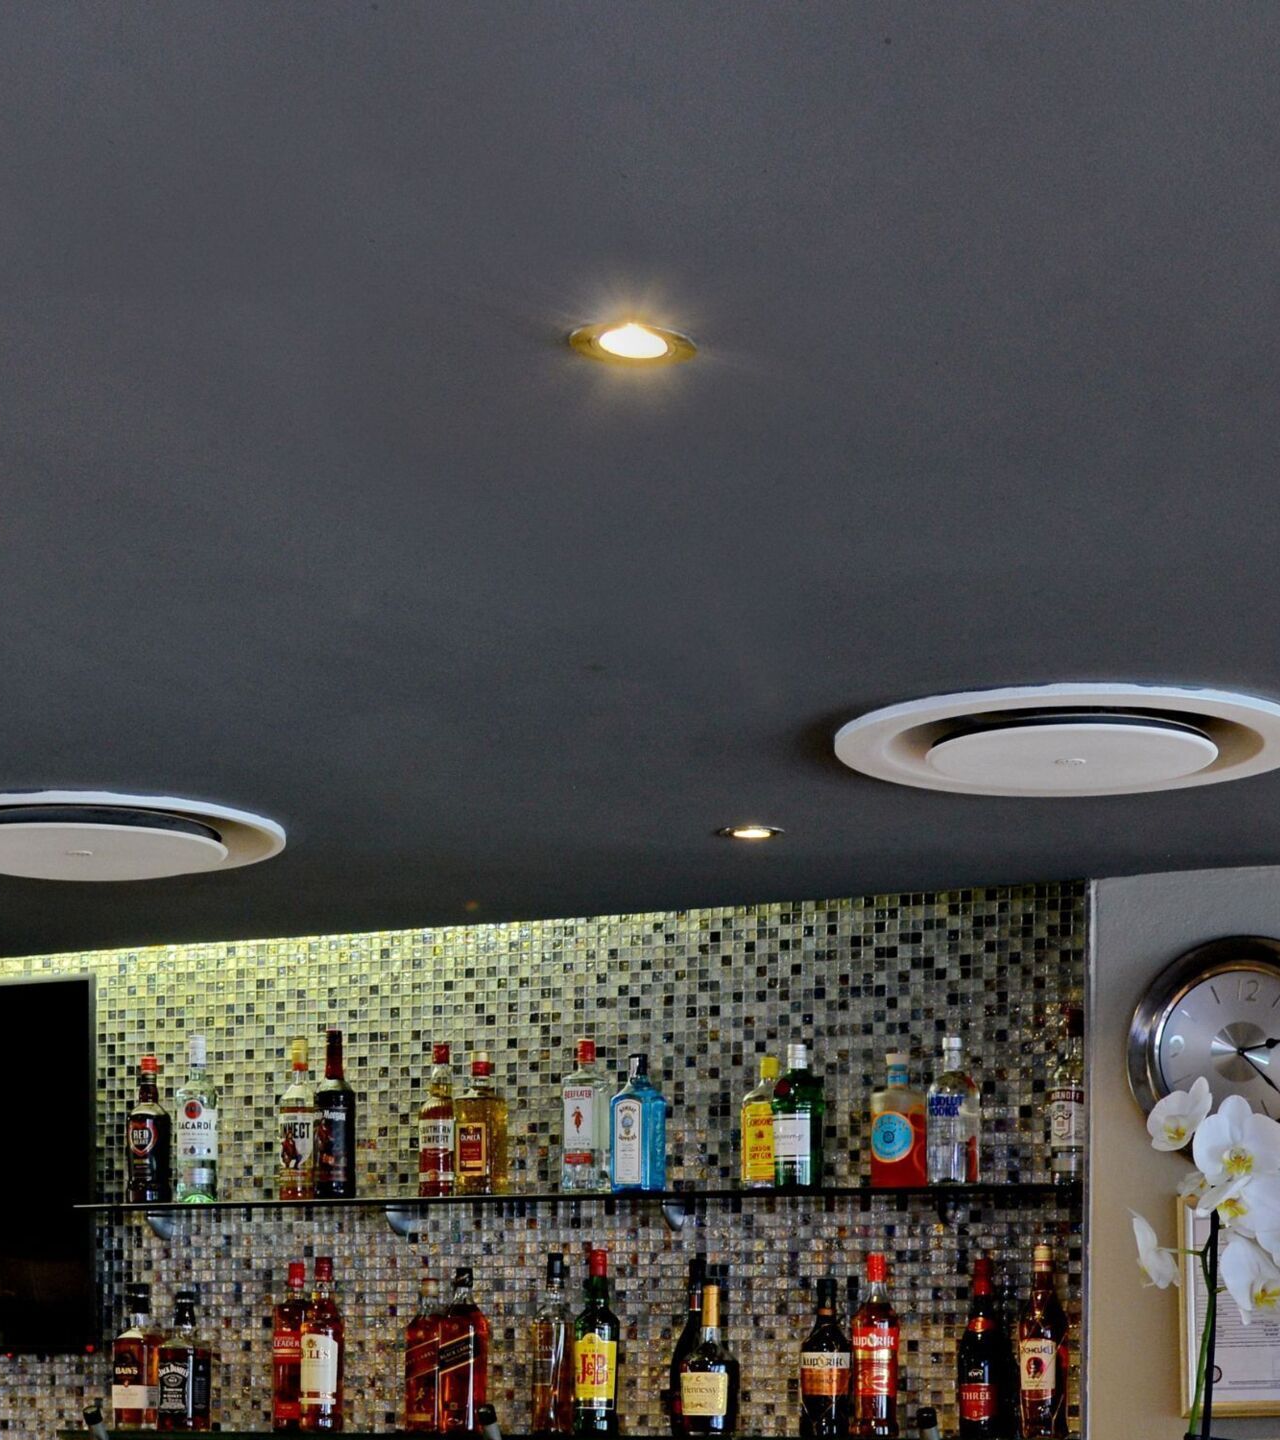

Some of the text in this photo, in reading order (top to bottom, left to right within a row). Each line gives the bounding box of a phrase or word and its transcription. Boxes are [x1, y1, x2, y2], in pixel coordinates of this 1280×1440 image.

[1237, 979, 1261, 1002] 12
[564, 1089, 592, 1099] BEEFEATER
[133, 1129, 149, 1139] RED
[274, 1340, 300, 1348] LEADER
[115, 1366, 138, 1375] BAIN'S
[576, 1353, 608, 1385] J&B
[682, 1385, 719, 1395] Hennessy
[962, 1391, 991, 1401] THREE
